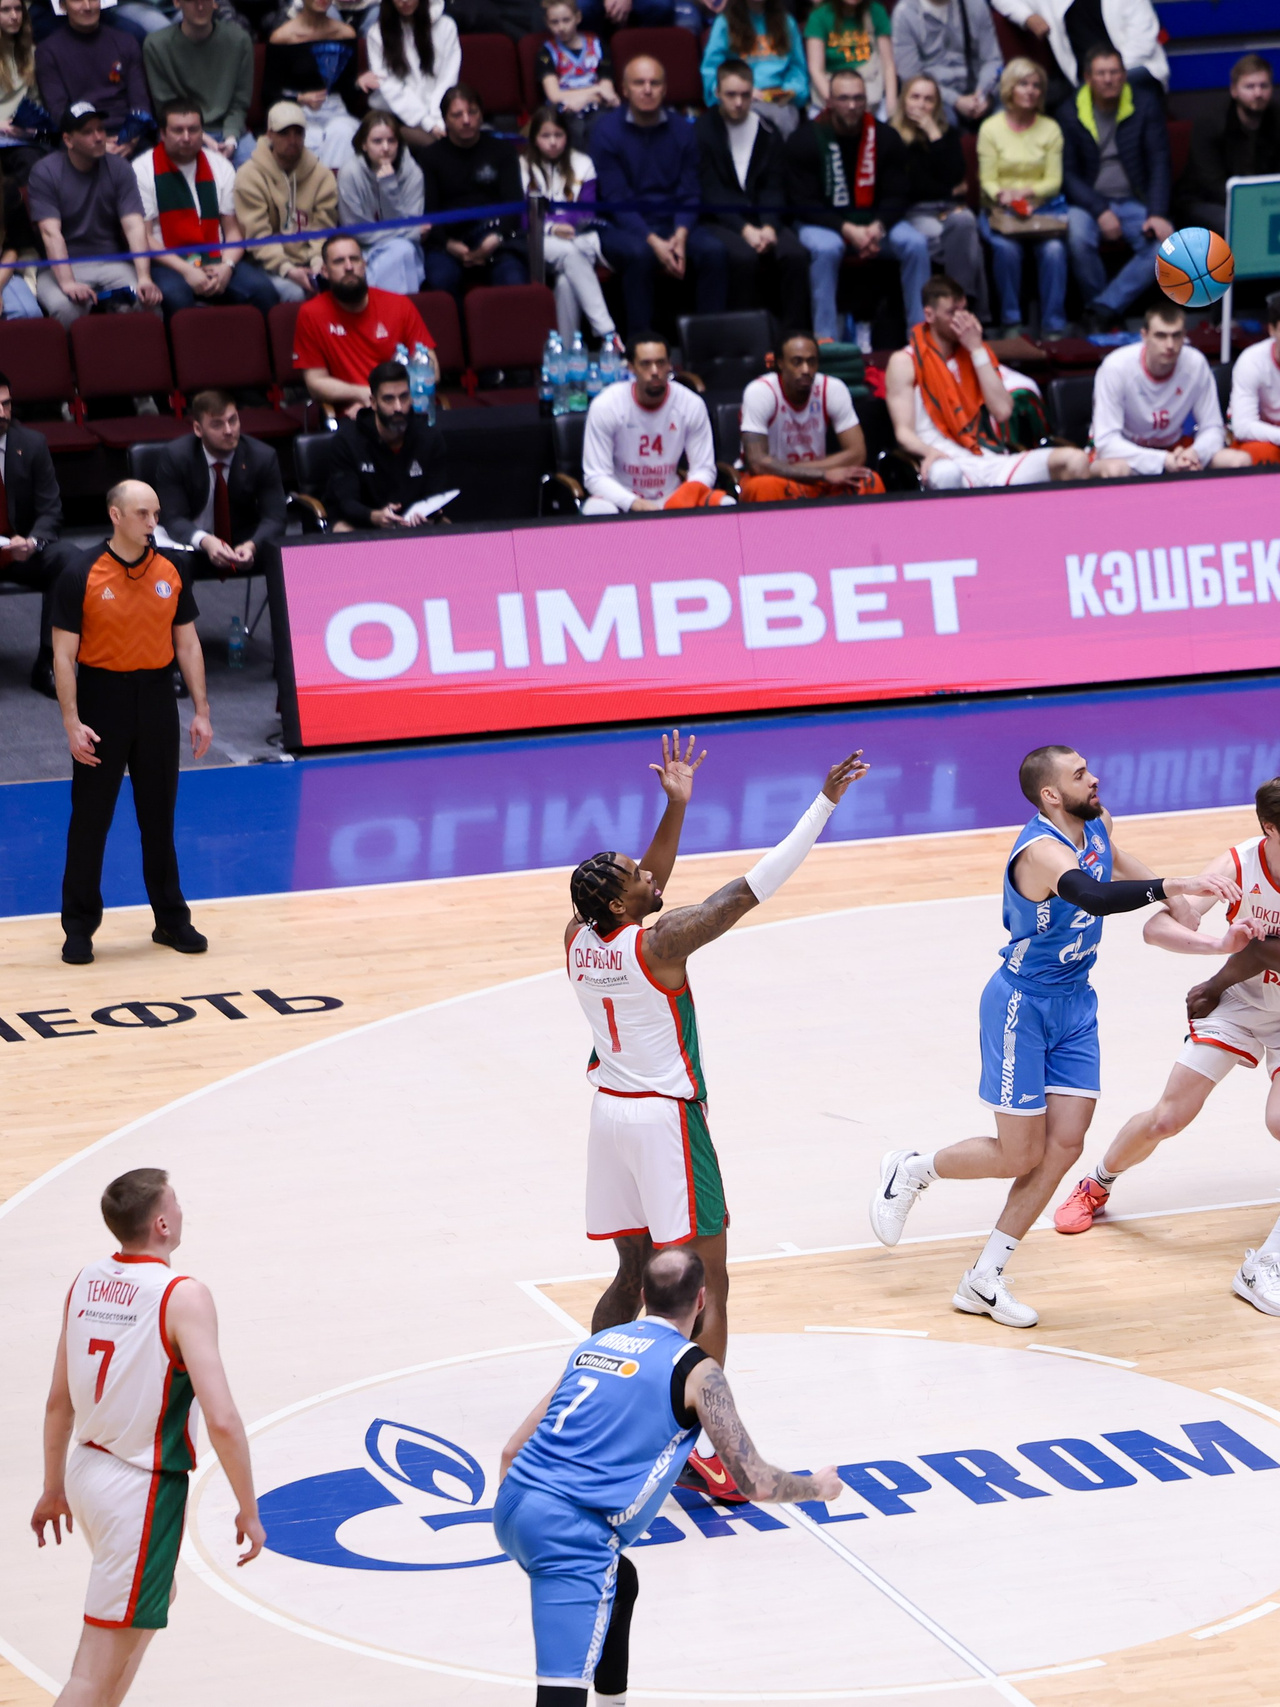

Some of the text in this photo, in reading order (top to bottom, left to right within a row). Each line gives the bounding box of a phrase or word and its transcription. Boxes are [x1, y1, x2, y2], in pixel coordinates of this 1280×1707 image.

[1150, 409, 1171, 431] 16
[638, 434, 664, 457] 24
[324, 558, 978, 682] OLIMPBET
[602, 997, 622, 1053] 1
[87, 1279, 140, 1307] TEMIROV
[87, 1338, 116, 1405] 7
[578, 1354, 619, 1371] Winline
[552, 1375, 600, 1434] 7
